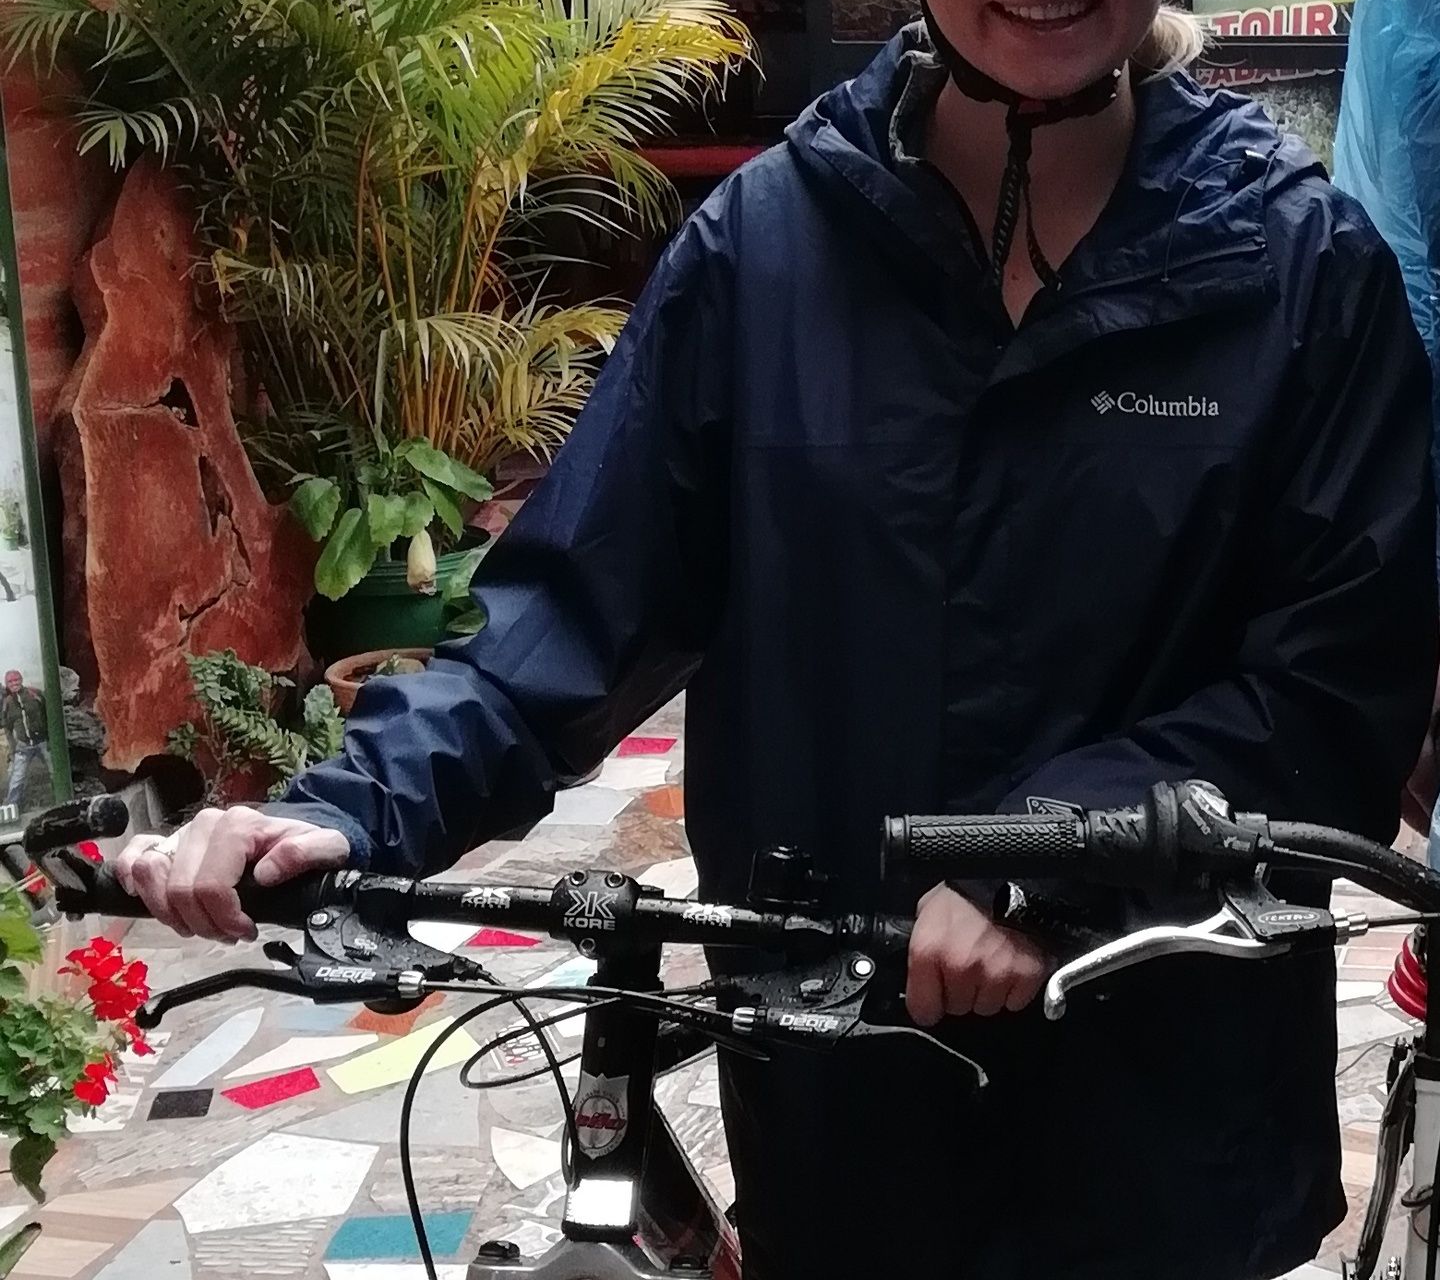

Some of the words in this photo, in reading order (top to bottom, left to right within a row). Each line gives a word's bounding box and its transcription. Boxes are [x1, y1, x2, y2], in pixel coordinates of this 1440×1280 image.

[1212, 2, 1336, 36] TOUR
[1117, 391, 1220, 417] Columbia
[563, 916, 616, 931] KORE
